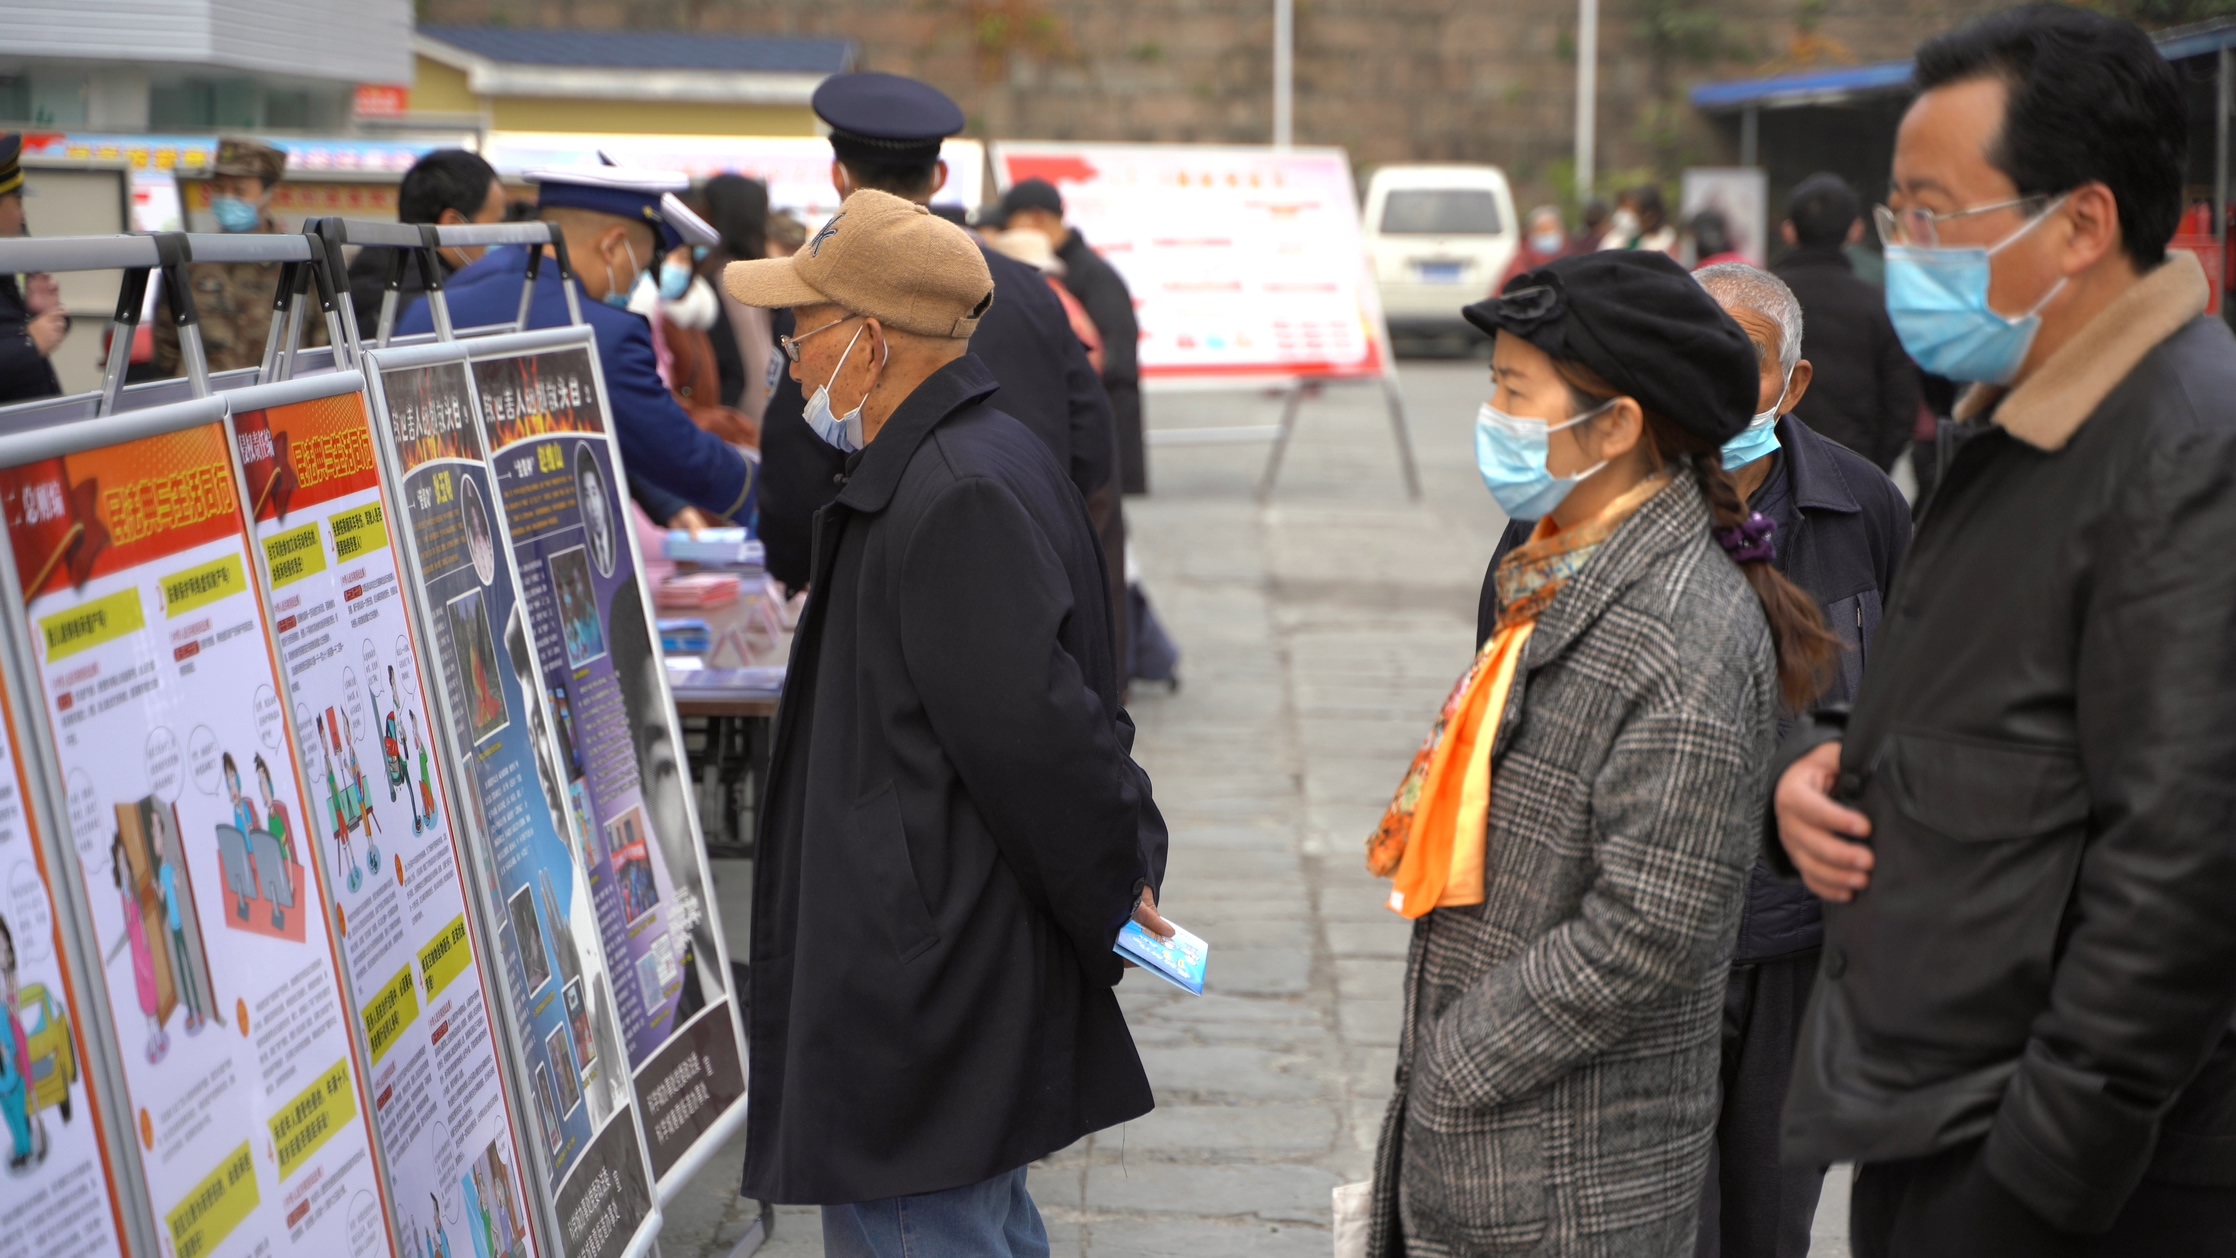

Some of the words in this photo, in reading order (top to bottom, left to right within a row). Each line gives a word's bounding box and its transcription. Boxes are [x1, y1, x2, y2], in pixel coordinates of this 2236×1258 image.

[291, 426, 375, 488] 民法典与生活同行
[103, 461, 236, 546] 民法典与生活同行
